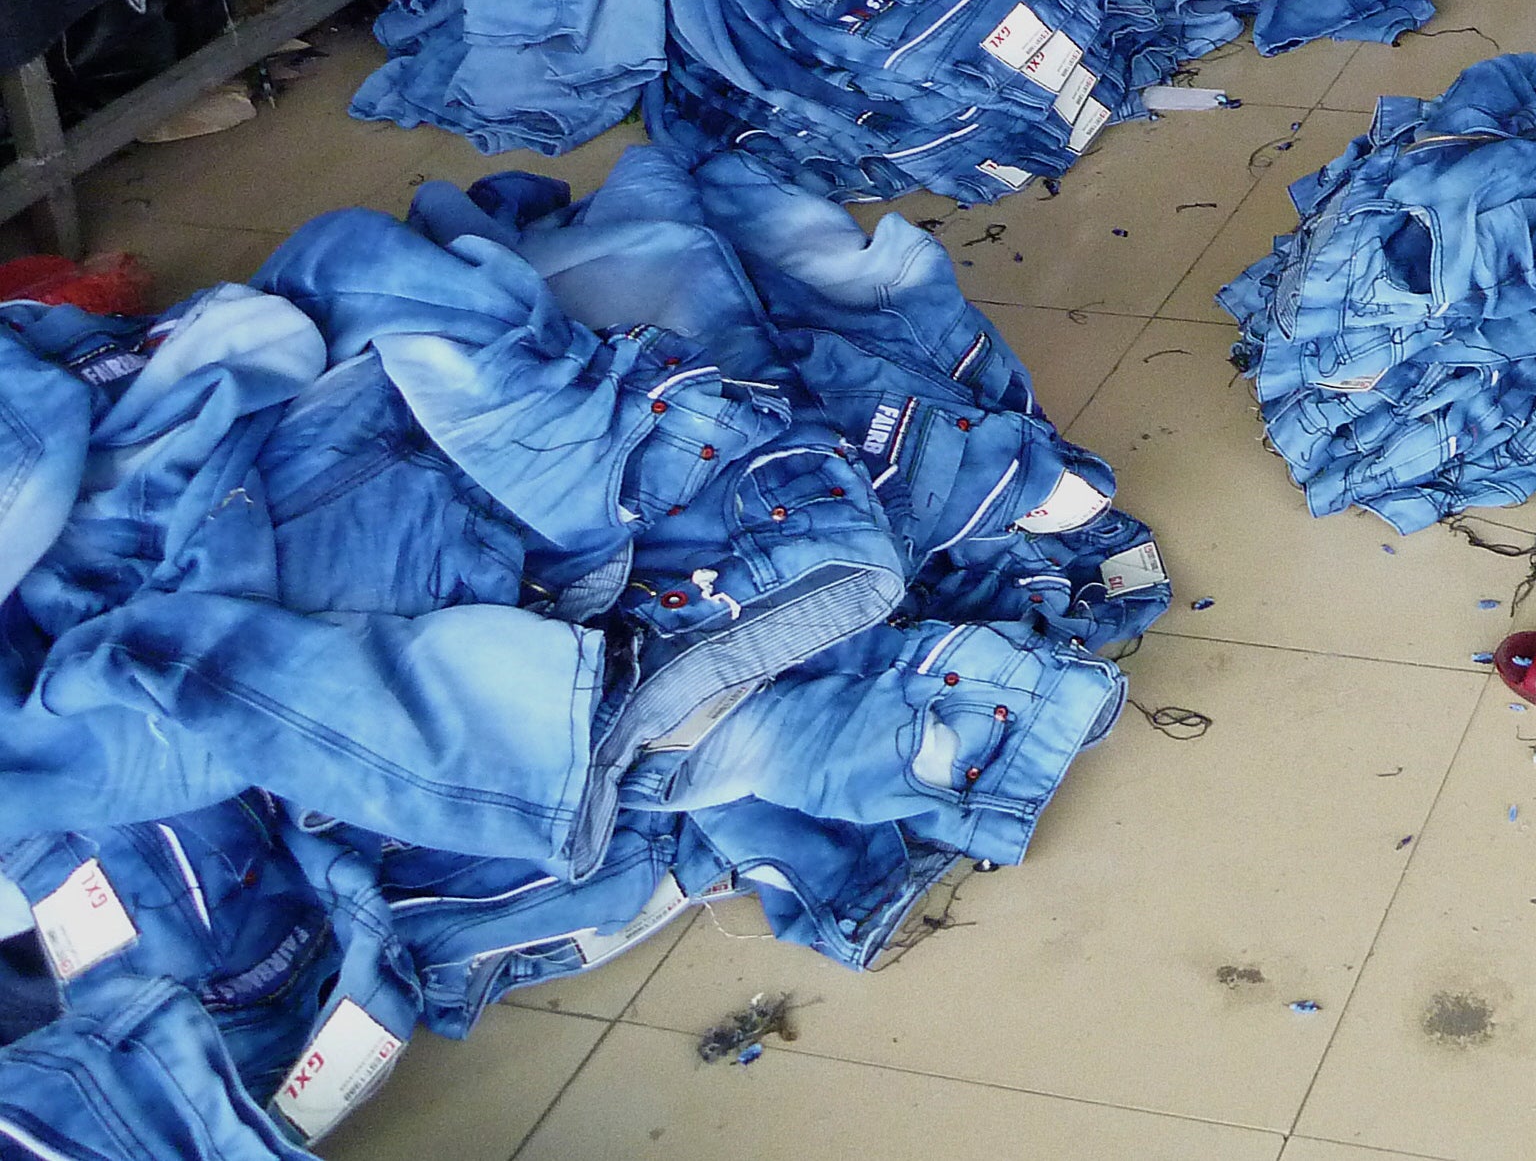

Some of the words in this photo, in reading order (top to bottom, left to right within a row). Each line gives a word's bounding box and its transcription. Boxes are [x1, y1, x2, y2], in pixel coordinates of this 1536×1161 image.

[989, 25, 1012, 49] GXL
[863, 404, 900, 454] FAIRB
[82, 871, 109, 909] GXL
[285, 1051, 325, 1099] GXL
